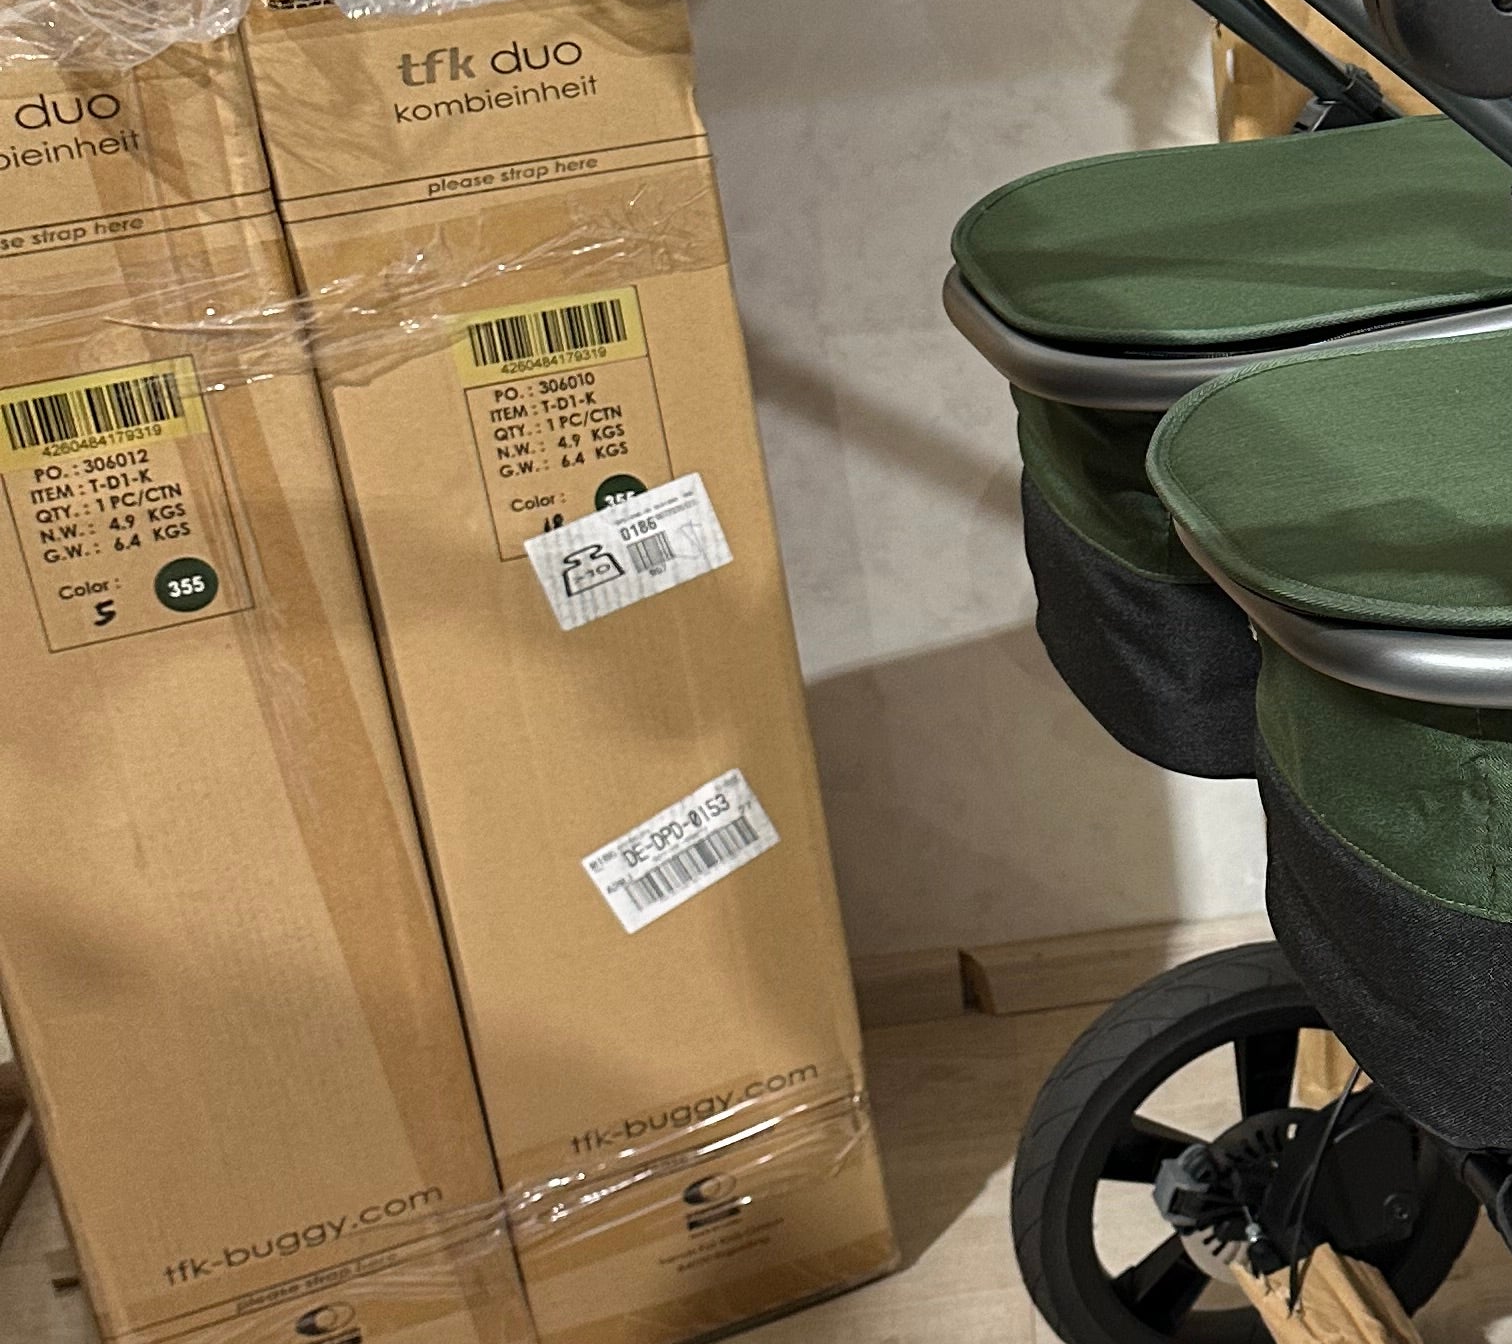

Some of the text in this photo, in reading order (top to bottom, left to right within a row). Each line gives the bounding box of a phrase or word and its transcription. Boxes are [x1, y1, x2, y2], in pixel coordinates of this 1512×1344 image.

[396, 41, 582, 87] tfk duo
[15, 93, 120, 129] duo
[394, 75, 598, 123] kombieinheit
[428, 157, 599, 197] please strap here
[32, 226, 86, 245] strap
[94, 218, 144, 234] here
[539, 372, 595, 395] 306010
[541, 391, 597, 414] T-D1-K
[559, 405, 623, 429] PC/CTN
[558, 434, 581, 449] 4.9
[590, 423, 626, 441] KGS
[83, 449, 149, 474] 306012
[561, 452, 585, 468] 6.4
[594, 441, 629, 460] KGS
[89, 468, 153, 493] T-D1-K
[110, 483, 182, 509] PC/CTN
[109, 514, 135, 531] 4.9
[147, 503, 186, 523] KGS
[114, 533, 141, 551] 6.4
[152, 522, 191, 542] KGS
[167, 575, 206, 598] 355
[163, 1185, 443, 1286] tfk-buggy.com
